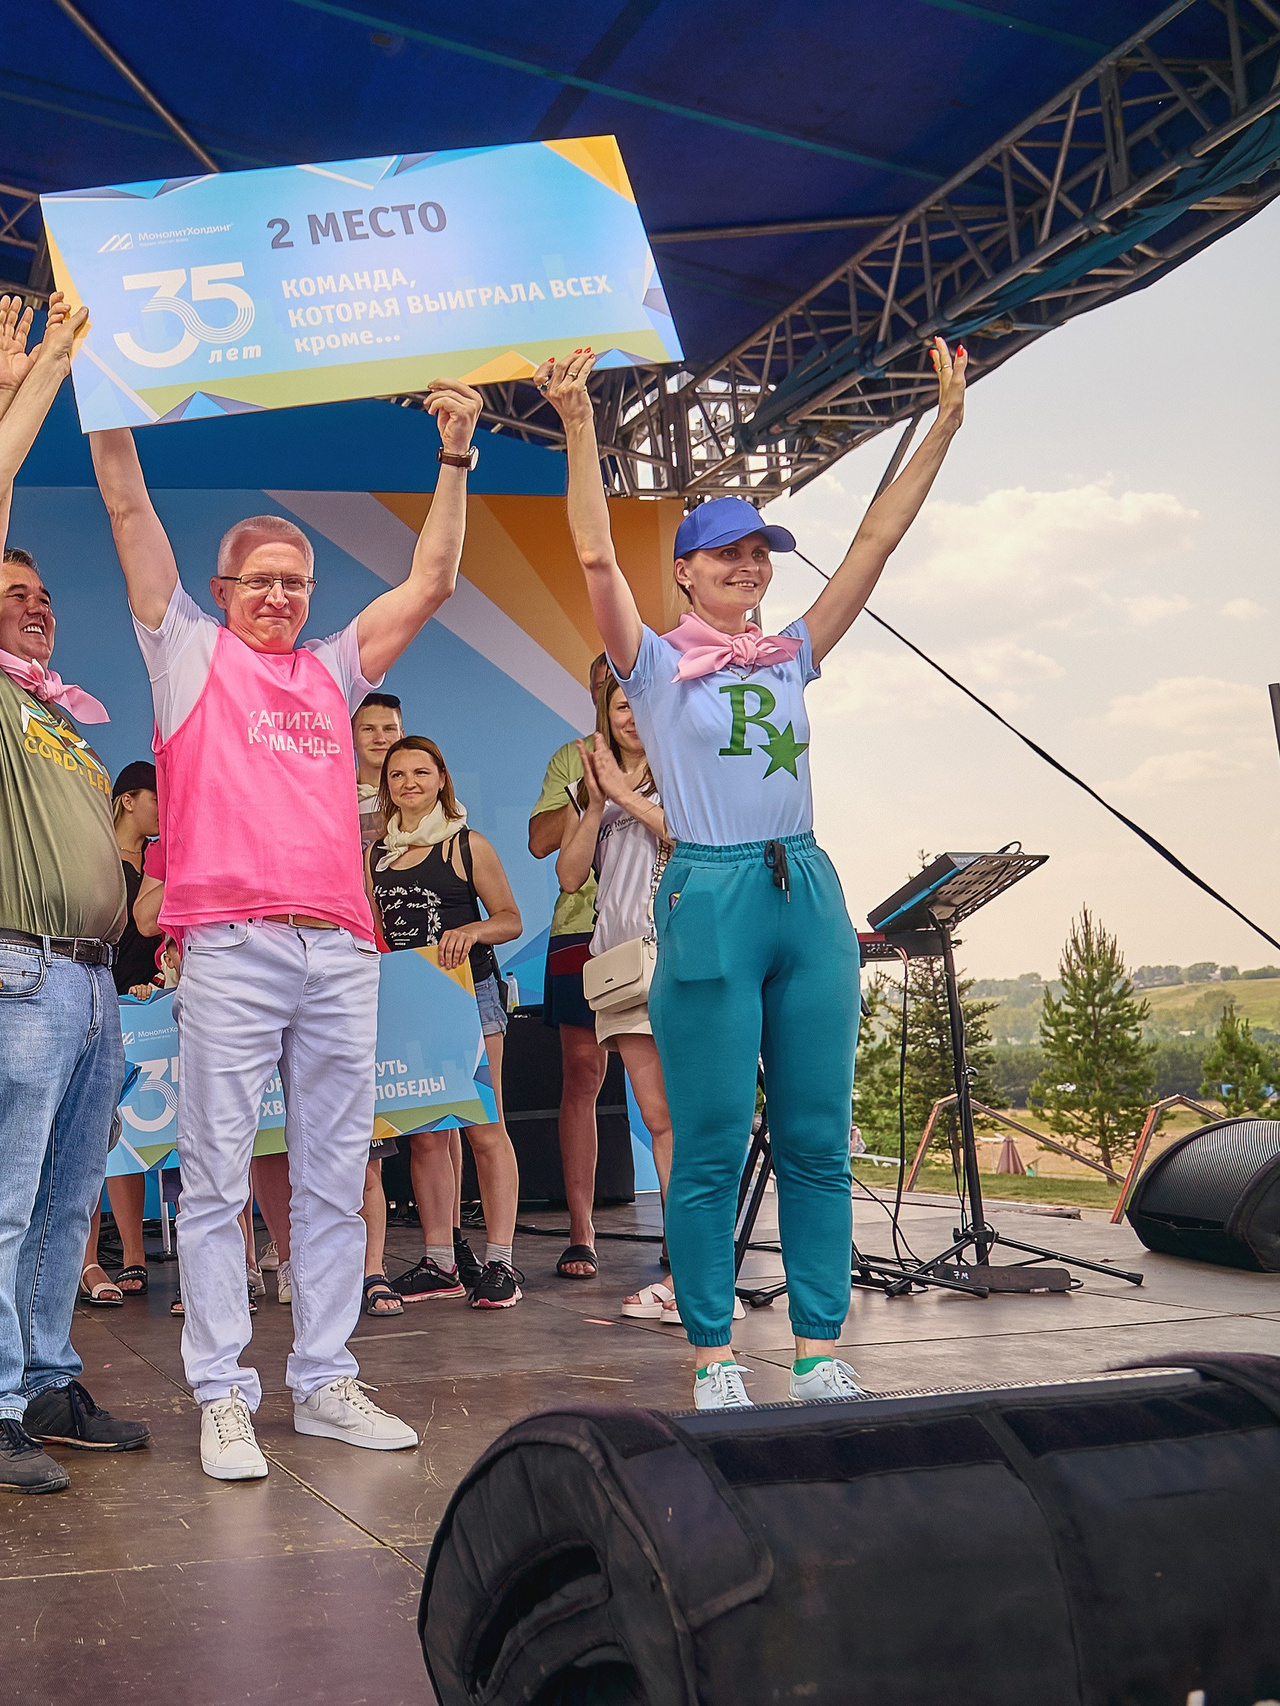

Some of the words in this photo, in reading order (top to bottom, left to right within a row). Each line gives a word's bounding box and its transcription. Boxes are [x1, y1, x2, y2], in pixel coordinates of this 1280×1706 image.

[138, 223, 232, 242] МонолитХолдинг
[266, 217, 294, 249] 2
[307, 201, 447, 246] МЕСТО
[281, 267, 417, 299] КОМАНДА,
[112, 261, 256, 369] 35
[287, 297, 401, 329] КОТОРАЯ
[406, 281, 546, 315] ВЫИГРАЛА
[549, 274, 613, 300] ВСЕХ
[208, 344, 262, 364] лет
[294, 329, 401, 356] кроме...
